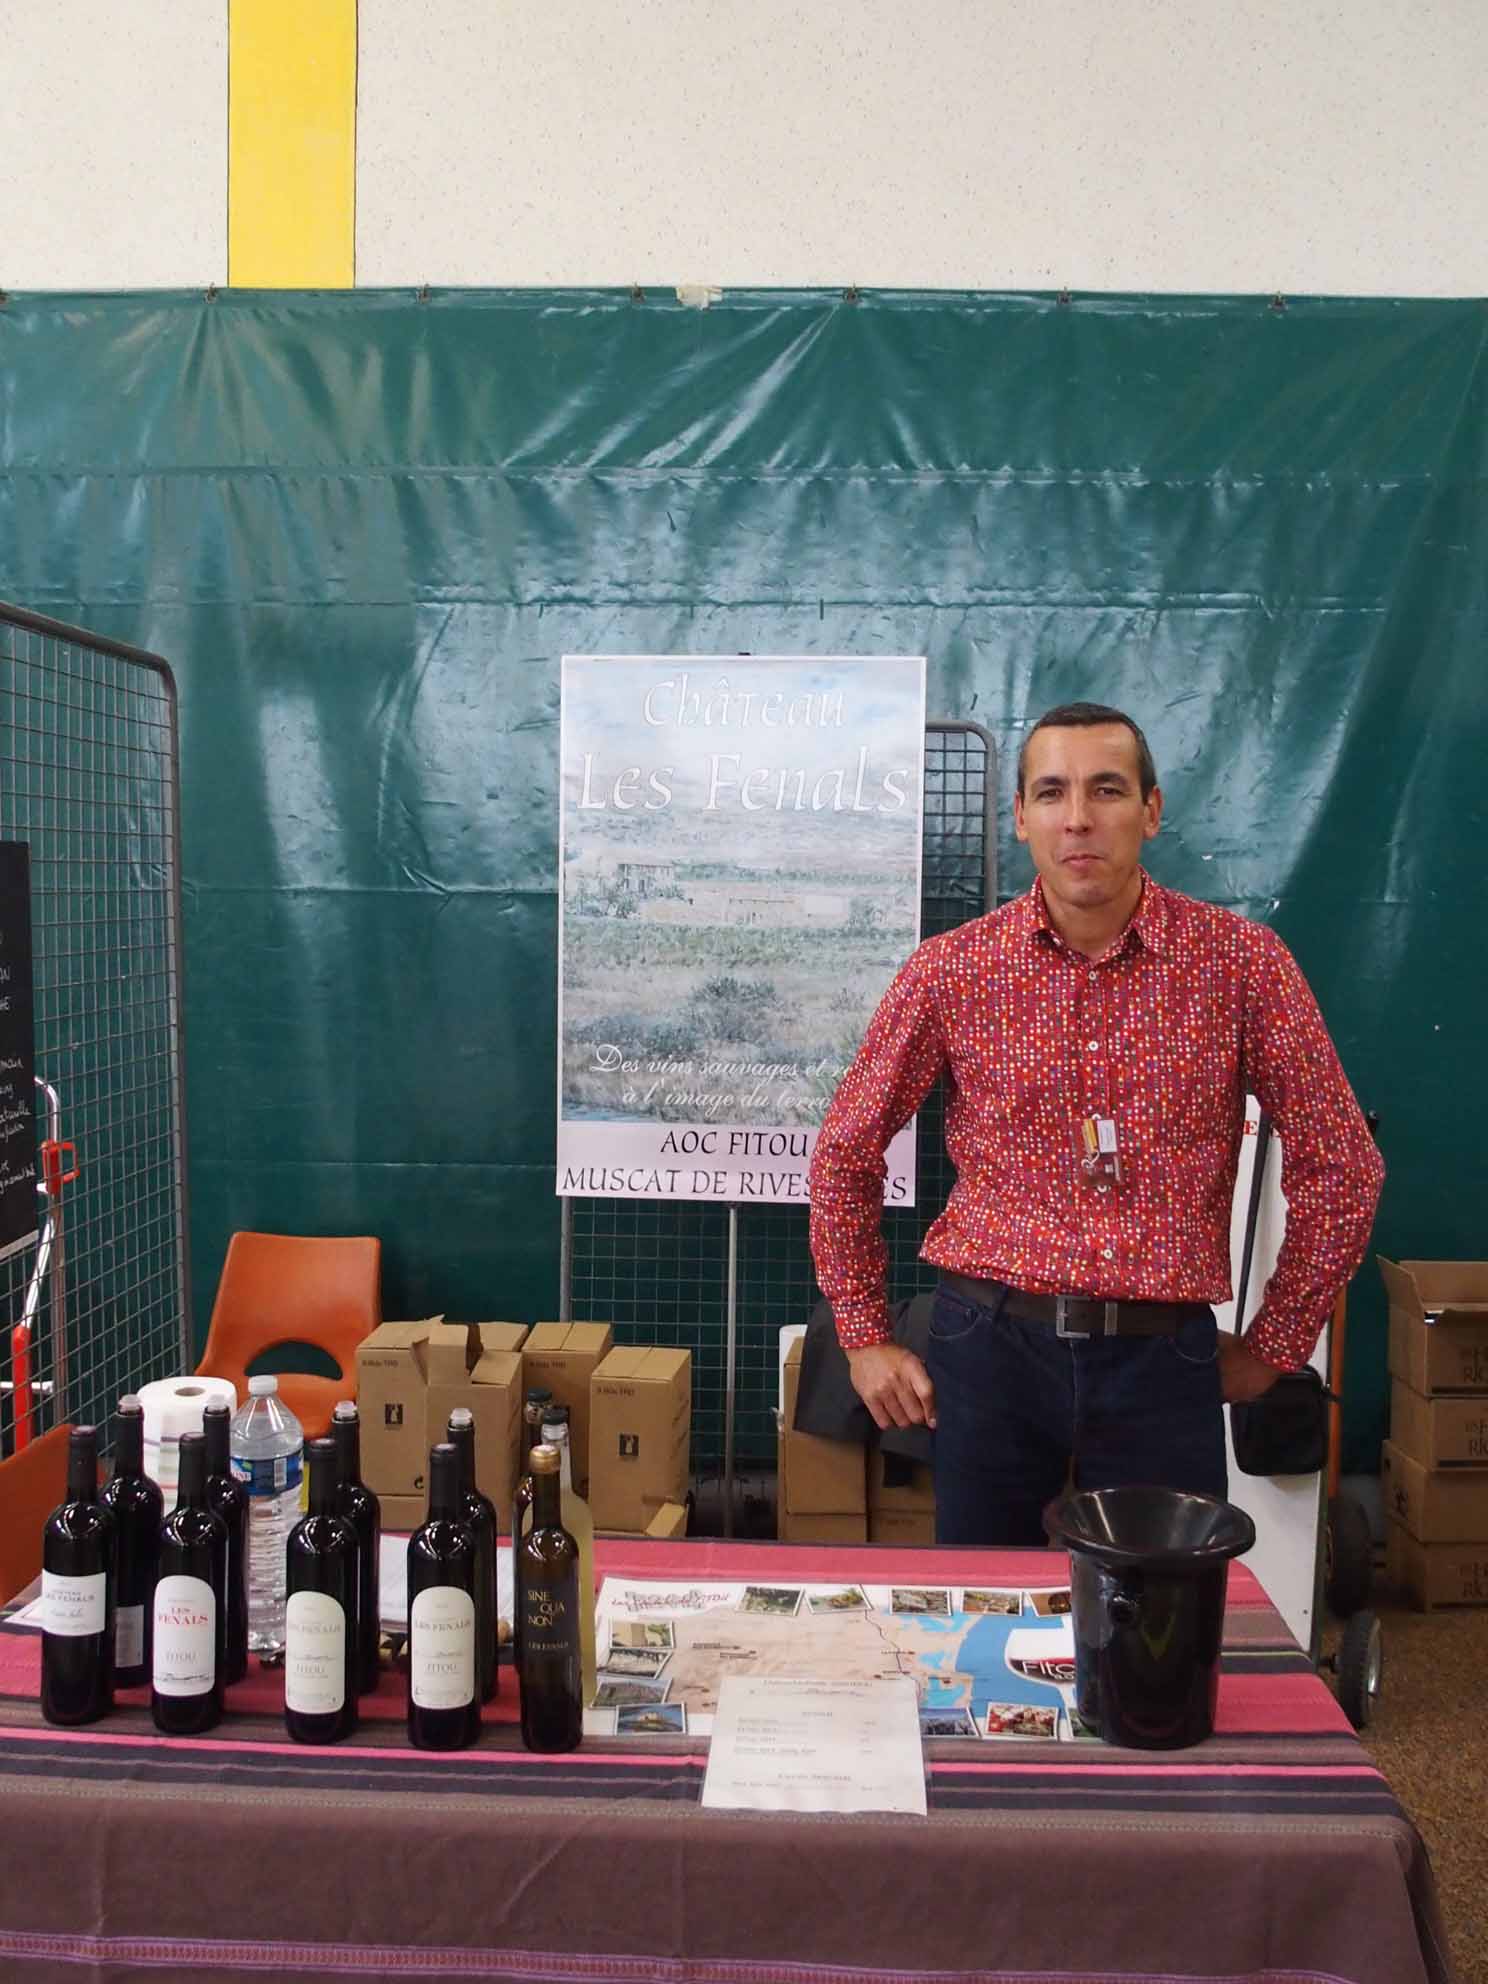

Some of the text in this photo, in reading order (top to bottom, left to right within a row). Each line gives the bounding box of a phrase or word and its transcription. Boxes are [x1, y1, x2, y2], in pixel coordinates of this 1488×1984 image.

[643, 671, 849, 729] Château
[576, 745, 912, 814] Les Fenals
[590, 1042, 640, 1075] Des
[646, 1054, 695, 1075] vins
[698, 1058, 800, 1088] sauvages
[621, 1084, 638, 1105] à
[740, 1086, 770, 1108] du
[777, 1090, 832, 1114] terro
[660, 1130, 809, 1158] AOC FITOU
[563, 1166, 681, 1194] MUSCAT
[692, 1169, 728, 1196] DE
